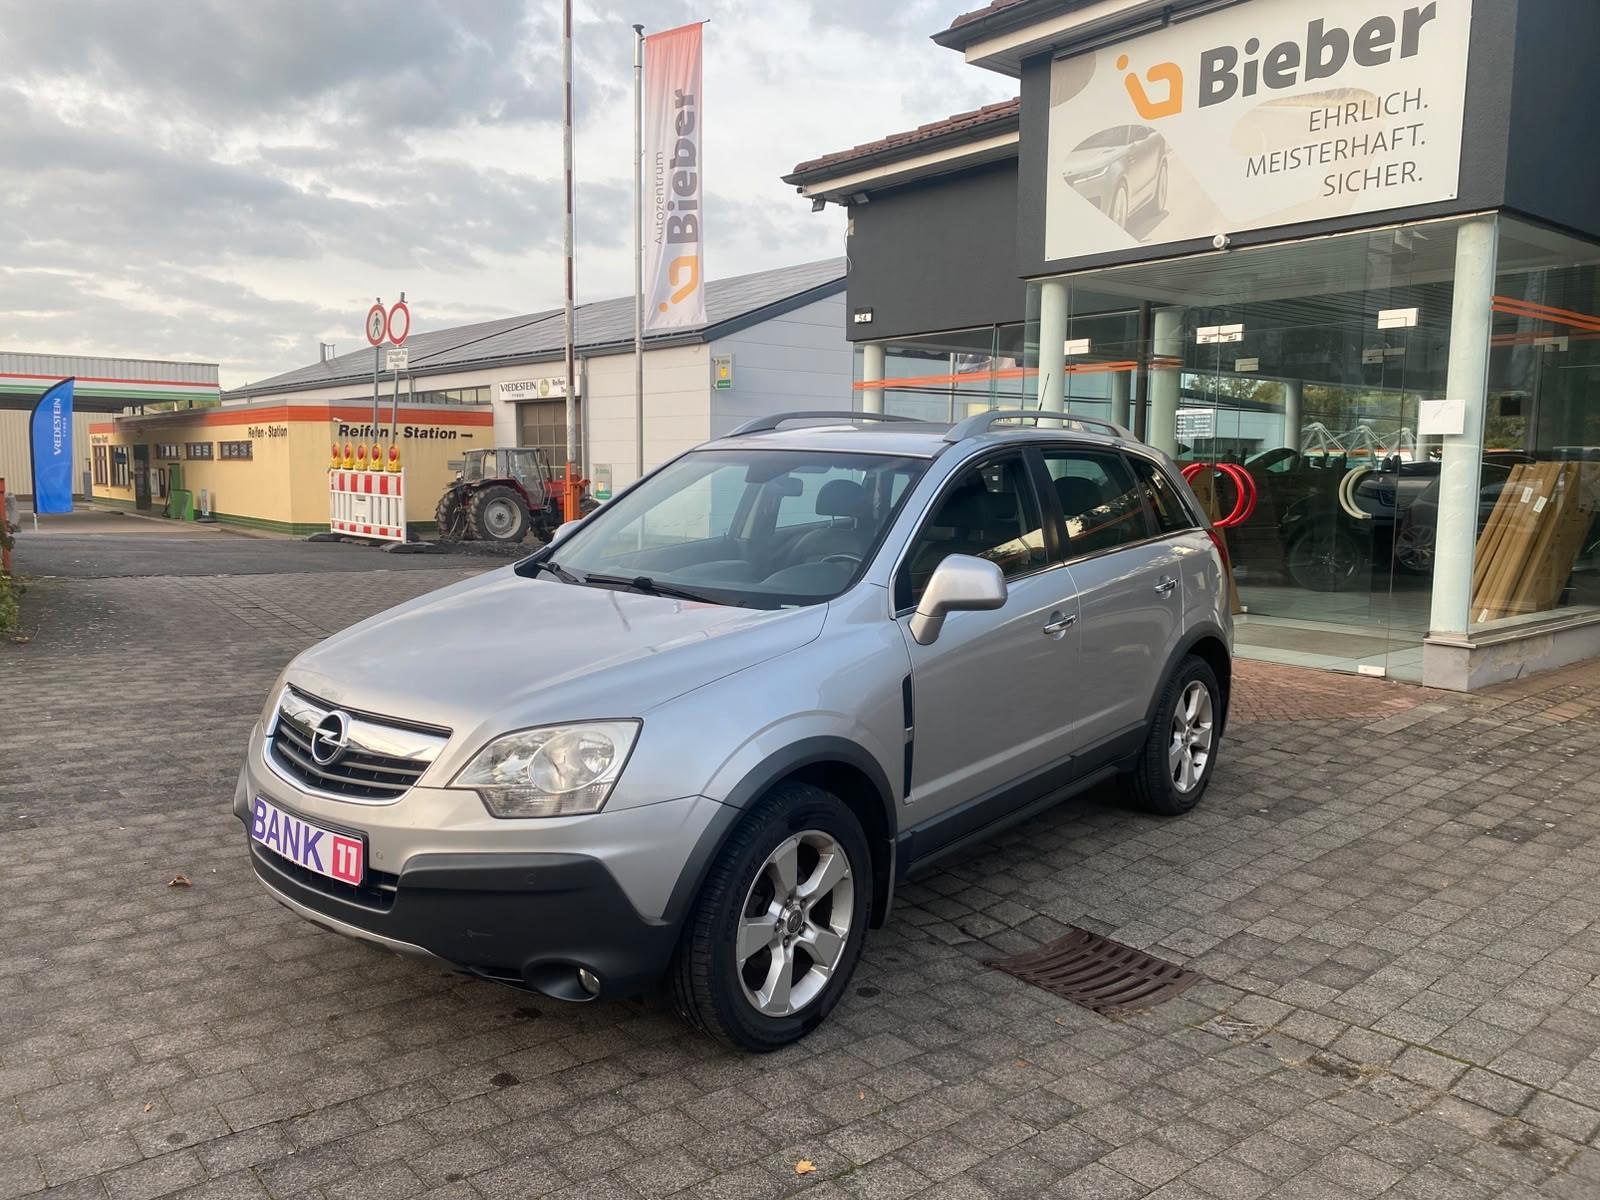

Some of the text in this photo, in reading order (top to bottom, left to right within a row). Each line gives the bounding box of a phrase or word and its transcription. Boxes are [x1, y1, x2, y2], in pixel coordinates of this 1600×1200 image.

[1199, 1, 1437, 108] Bieber
[1309, 88, 1429, 132] EHRLICH.
[667, 88, 699, 245] Bieber
[1246, 123, 1426, 178] MEISTERHAFT.
[654, 151, 664, 245] Autozentrum
[1323, 161, 1423, 197] SICHER.
[500, 381, 537, 393] VREDESTEIN
[53, 398, 62, 456] VREDESTEIN
[248, 426, 264, 439] Reifen
[268, 424, 288, 438] Station
[338, 424, 389, 438] Reifen
[403, 426, 457, 440] Station
[251, 799, 358, 877] BANK 11
